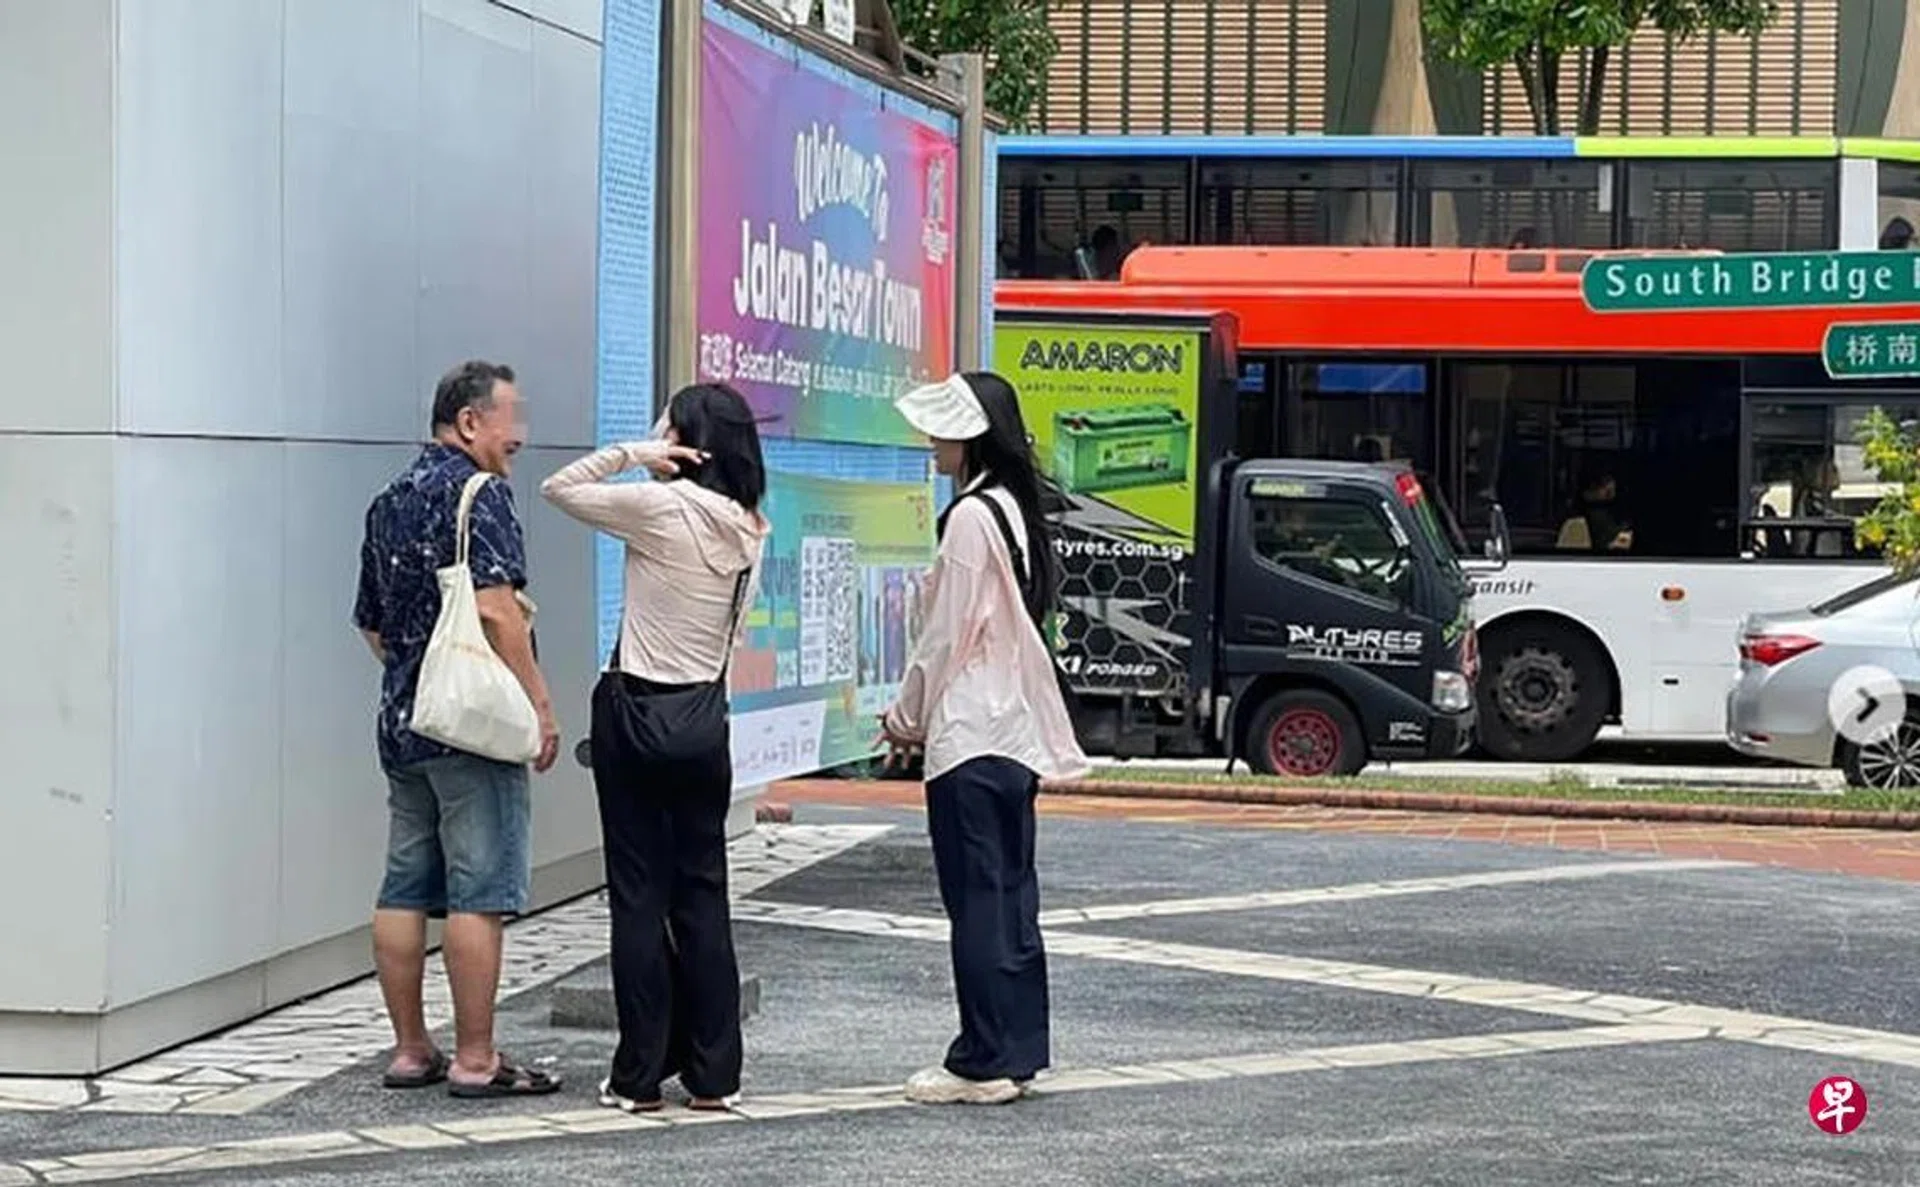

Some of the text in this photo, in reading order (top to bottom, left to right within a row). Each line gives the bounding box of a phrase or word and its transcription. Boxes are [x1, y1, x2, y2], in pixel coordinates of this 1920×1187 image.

[795, 121, 870, 222] Welcome
[734, 219, 808, 327] Jalan
[811, 240, 872, 342] Besar
[872, 258, 921, 351] Town
[1606, 262, 1731, 297] South
[1752, 259, 1893, 299] Bridge
[1020, 339, 1183, 374] AMARON
[1846, 333, 1918, 367] 桥南
[1052, 538, 1184, 561] tyres.com.sg
